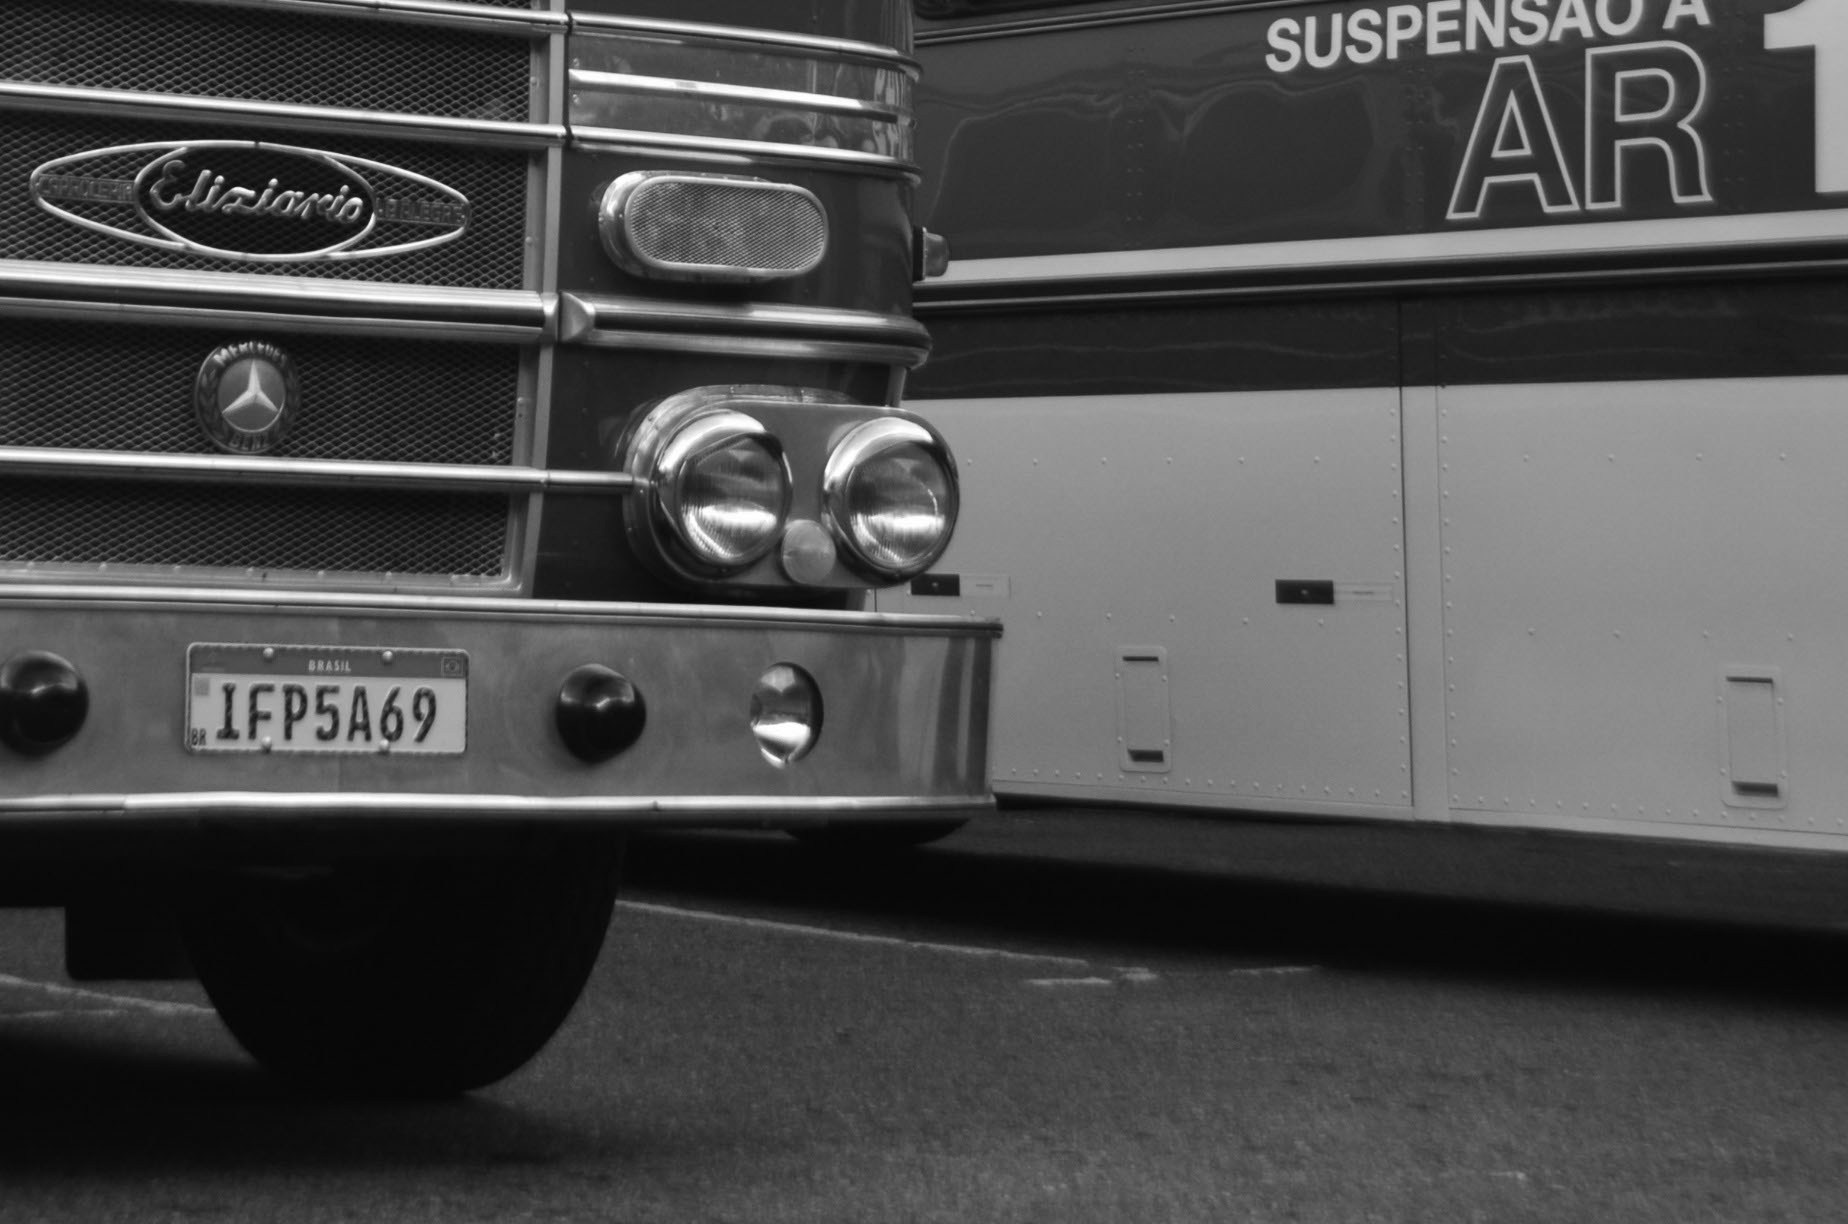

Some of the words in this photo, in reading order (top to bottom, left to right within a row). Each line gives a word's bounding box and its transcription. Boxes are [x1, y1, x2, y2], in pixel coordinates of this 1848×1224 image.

[1445, 39, 1715, 221] AR
[308, 659, 352, 673] BRASIL
[215, 681, 438, 744] IFP5A69
[191, 728, 207, 746] BR
